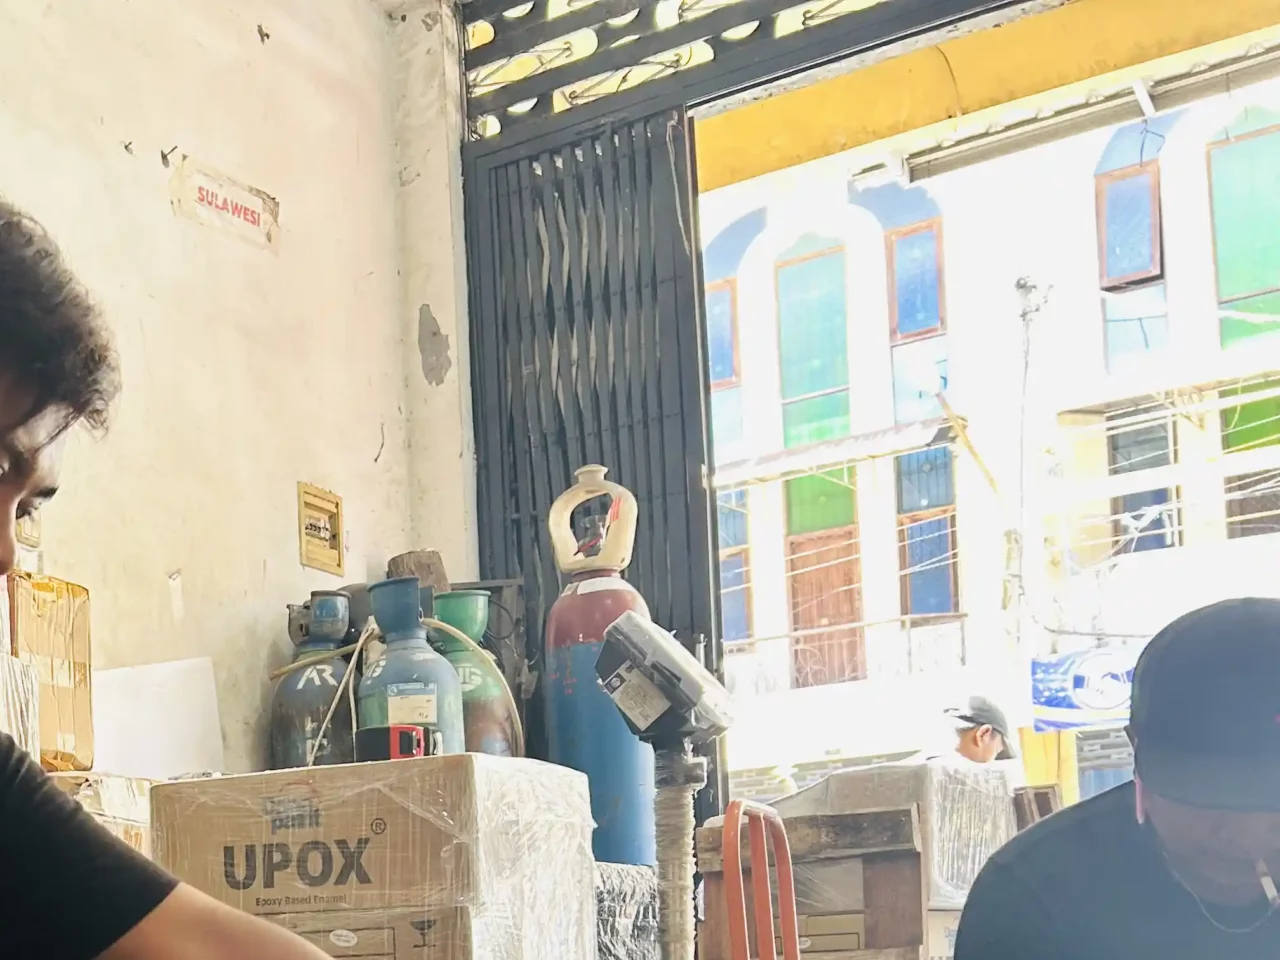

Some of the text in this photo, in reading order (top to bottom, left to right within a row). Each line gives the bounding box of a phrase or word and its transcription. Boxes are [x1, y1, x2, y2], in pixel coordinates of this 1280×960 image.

[197, 186, 261, 227] SULAWESI
[296, 664, 338, 690] AR
[223, 837, 372, 890] UPOX
[255, 893, 347, 907] Epoxy Based Enamel
